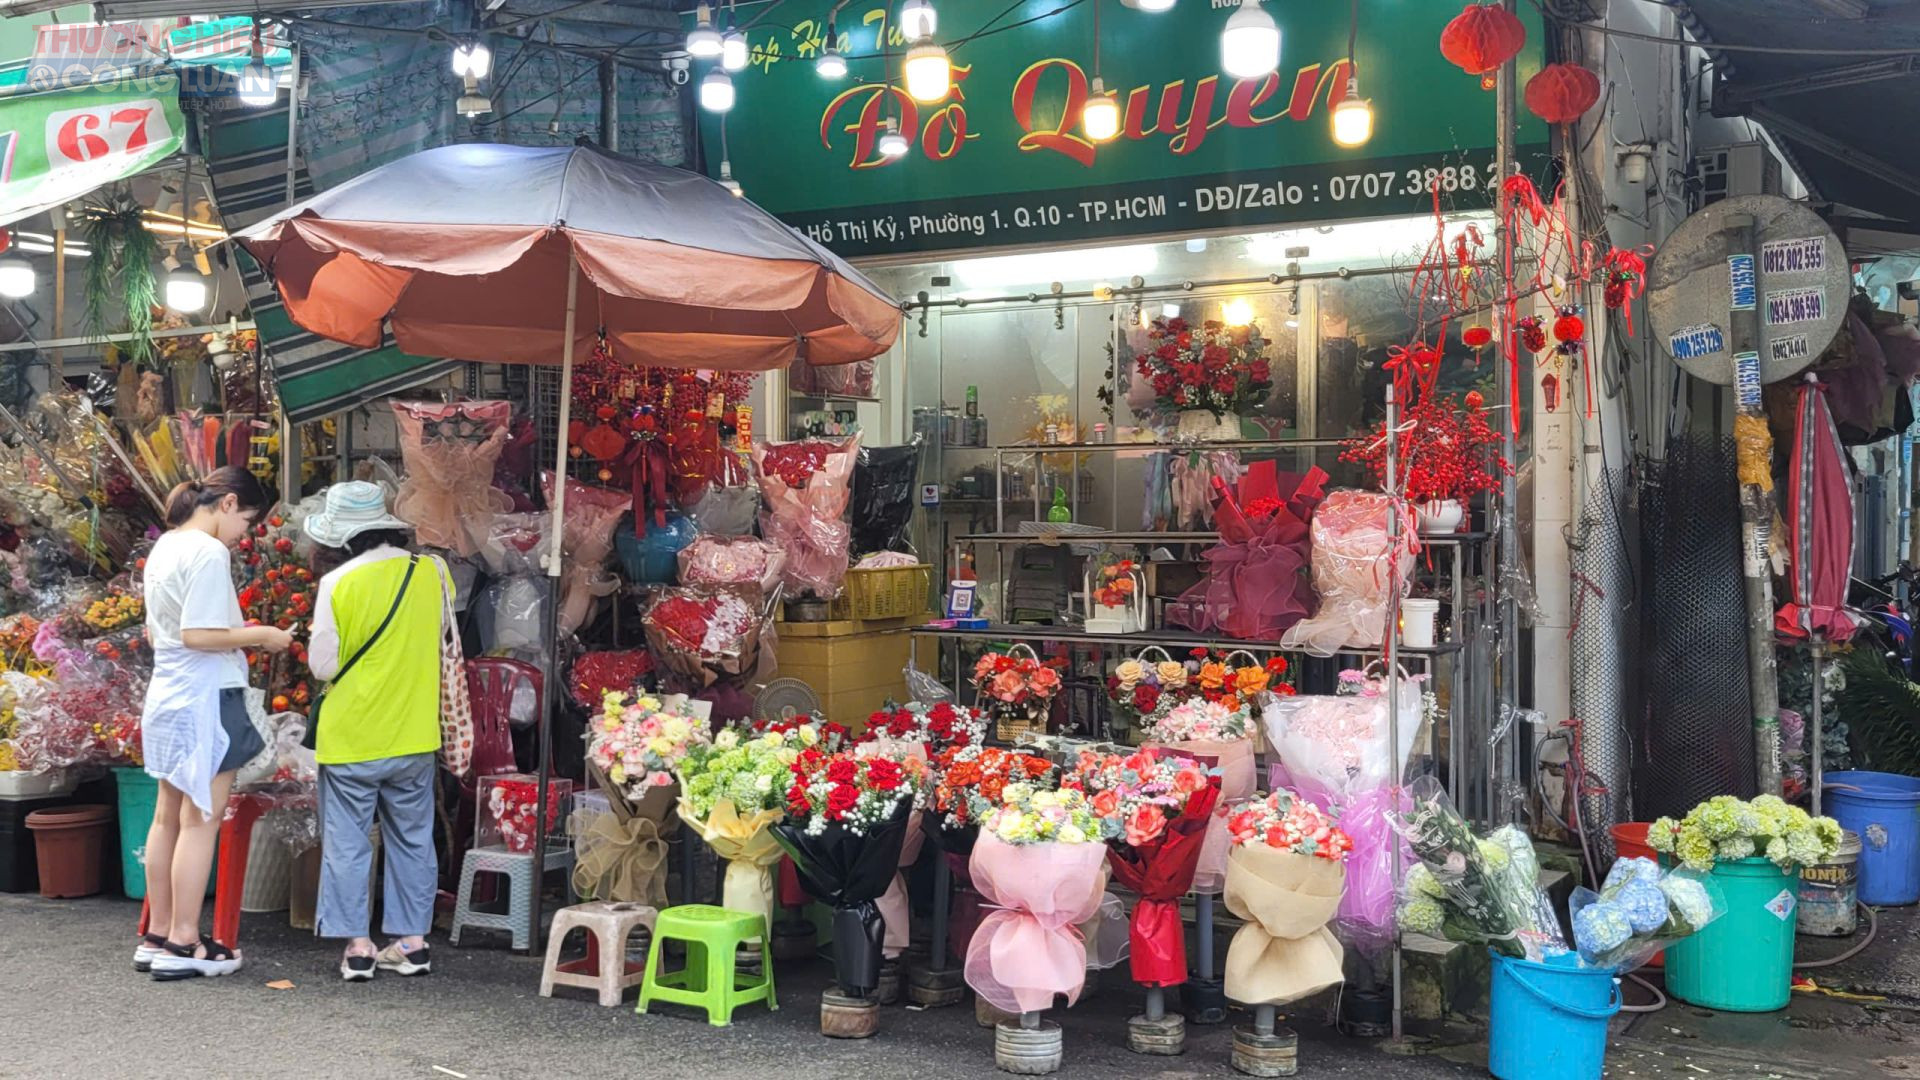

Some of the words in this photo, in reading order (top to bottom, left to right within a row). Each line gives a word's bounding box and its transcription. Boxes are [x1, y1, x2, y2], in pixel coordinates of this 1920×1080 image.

[57, 107, 153, 162] 67
[808, 220, 833, 243] Hồ
[837, 220, 868, 243] Thị
[910, 208, 985, 237] Phường
[991, 210, 1008, 230] 1.
[1014, 204, 1060, 229] Q.10
[1079, 195, 1167, 223] TP.HCM
[1196, 180, 1303, 212] DĐ/Zalo
[1330, 164, 1476, 201] 0707.3888
[1763, 249, 1785, 273] 0812
[1786, 247, 1803, 271] 802
[1804, 245, 1821, 269] 555
[1769, 298, 1790, 324] 0934
[1805, 294, 1821, 319] 599
